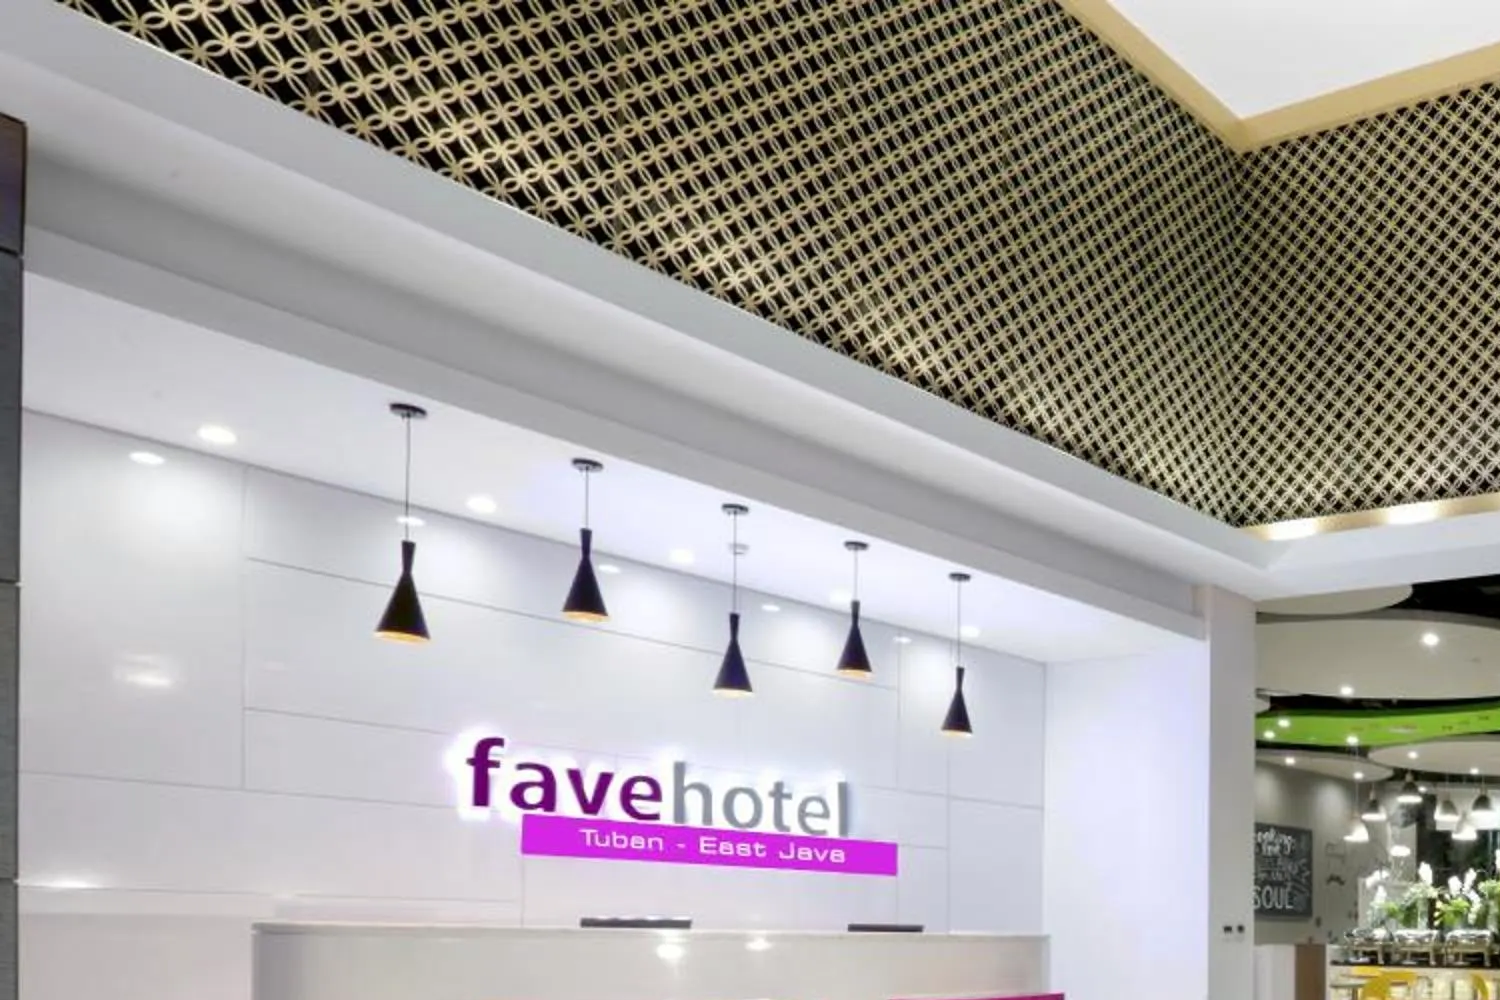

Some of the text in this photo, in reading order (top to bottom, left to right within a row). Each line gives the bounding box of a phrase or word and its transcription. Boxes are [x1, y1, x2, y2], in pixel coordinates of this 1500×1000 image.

[466, 737, 849, 837] favehotel
[579, 828, 663, 851] Tuban
[699, 836, 767, 858] East
[778, 842, 846, 864] Java
[1253, 885, 1294, 910] SOUL
